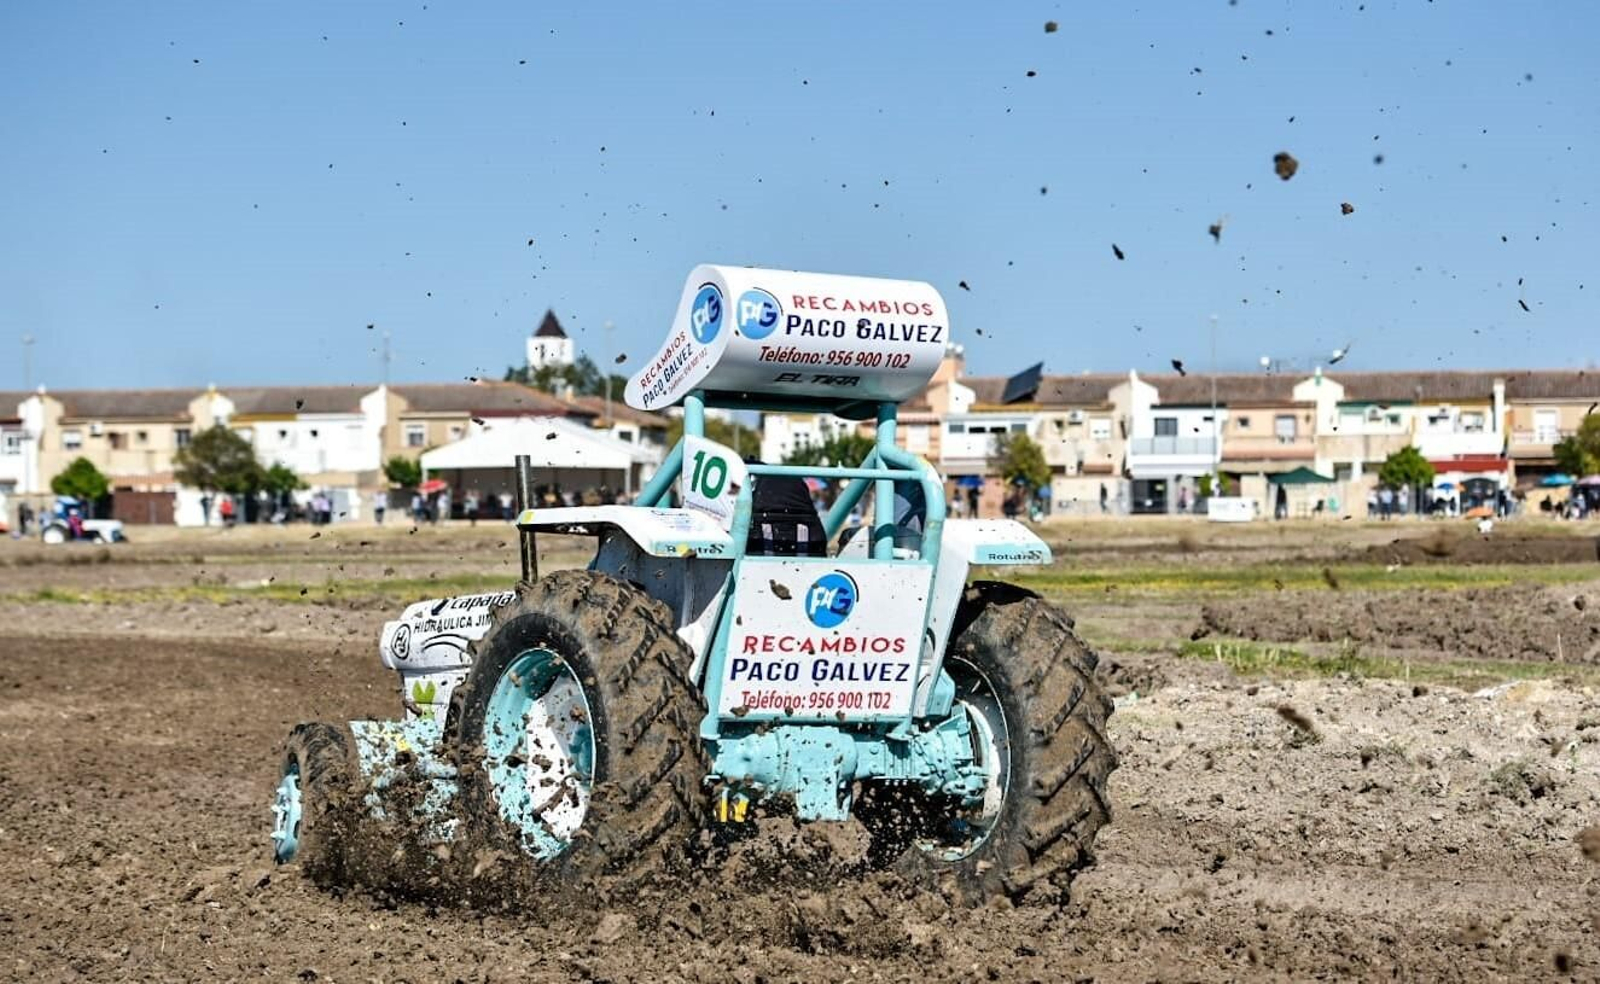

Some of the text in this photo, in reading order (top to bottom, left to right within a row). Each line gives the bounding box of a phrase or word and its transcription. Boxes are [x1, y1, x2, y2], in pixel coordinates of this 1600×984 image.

[793, 294, 934, 317] RECAMBIOS
[785, 314, 944, 343] PACO GALVEZ
[640, 331, 686, 389] RECAMBIOS
[758, 346, 911, 369] Teléfono: 956 900 102
[642, 378, 665, 408] PACO
[663, 342, 693, 383] GALVEZ
[774, 372, 802, 383] EL
[691, 450, 728, 500] 10
[414, 615, 472, 633] HIDRAULICA
[742, 635, 906, 653] RECAMBIOS
[730, 658, 911, 682] PACO GALVEZ
[741, 689, 891, 710] Teléfono: 956 900 102
